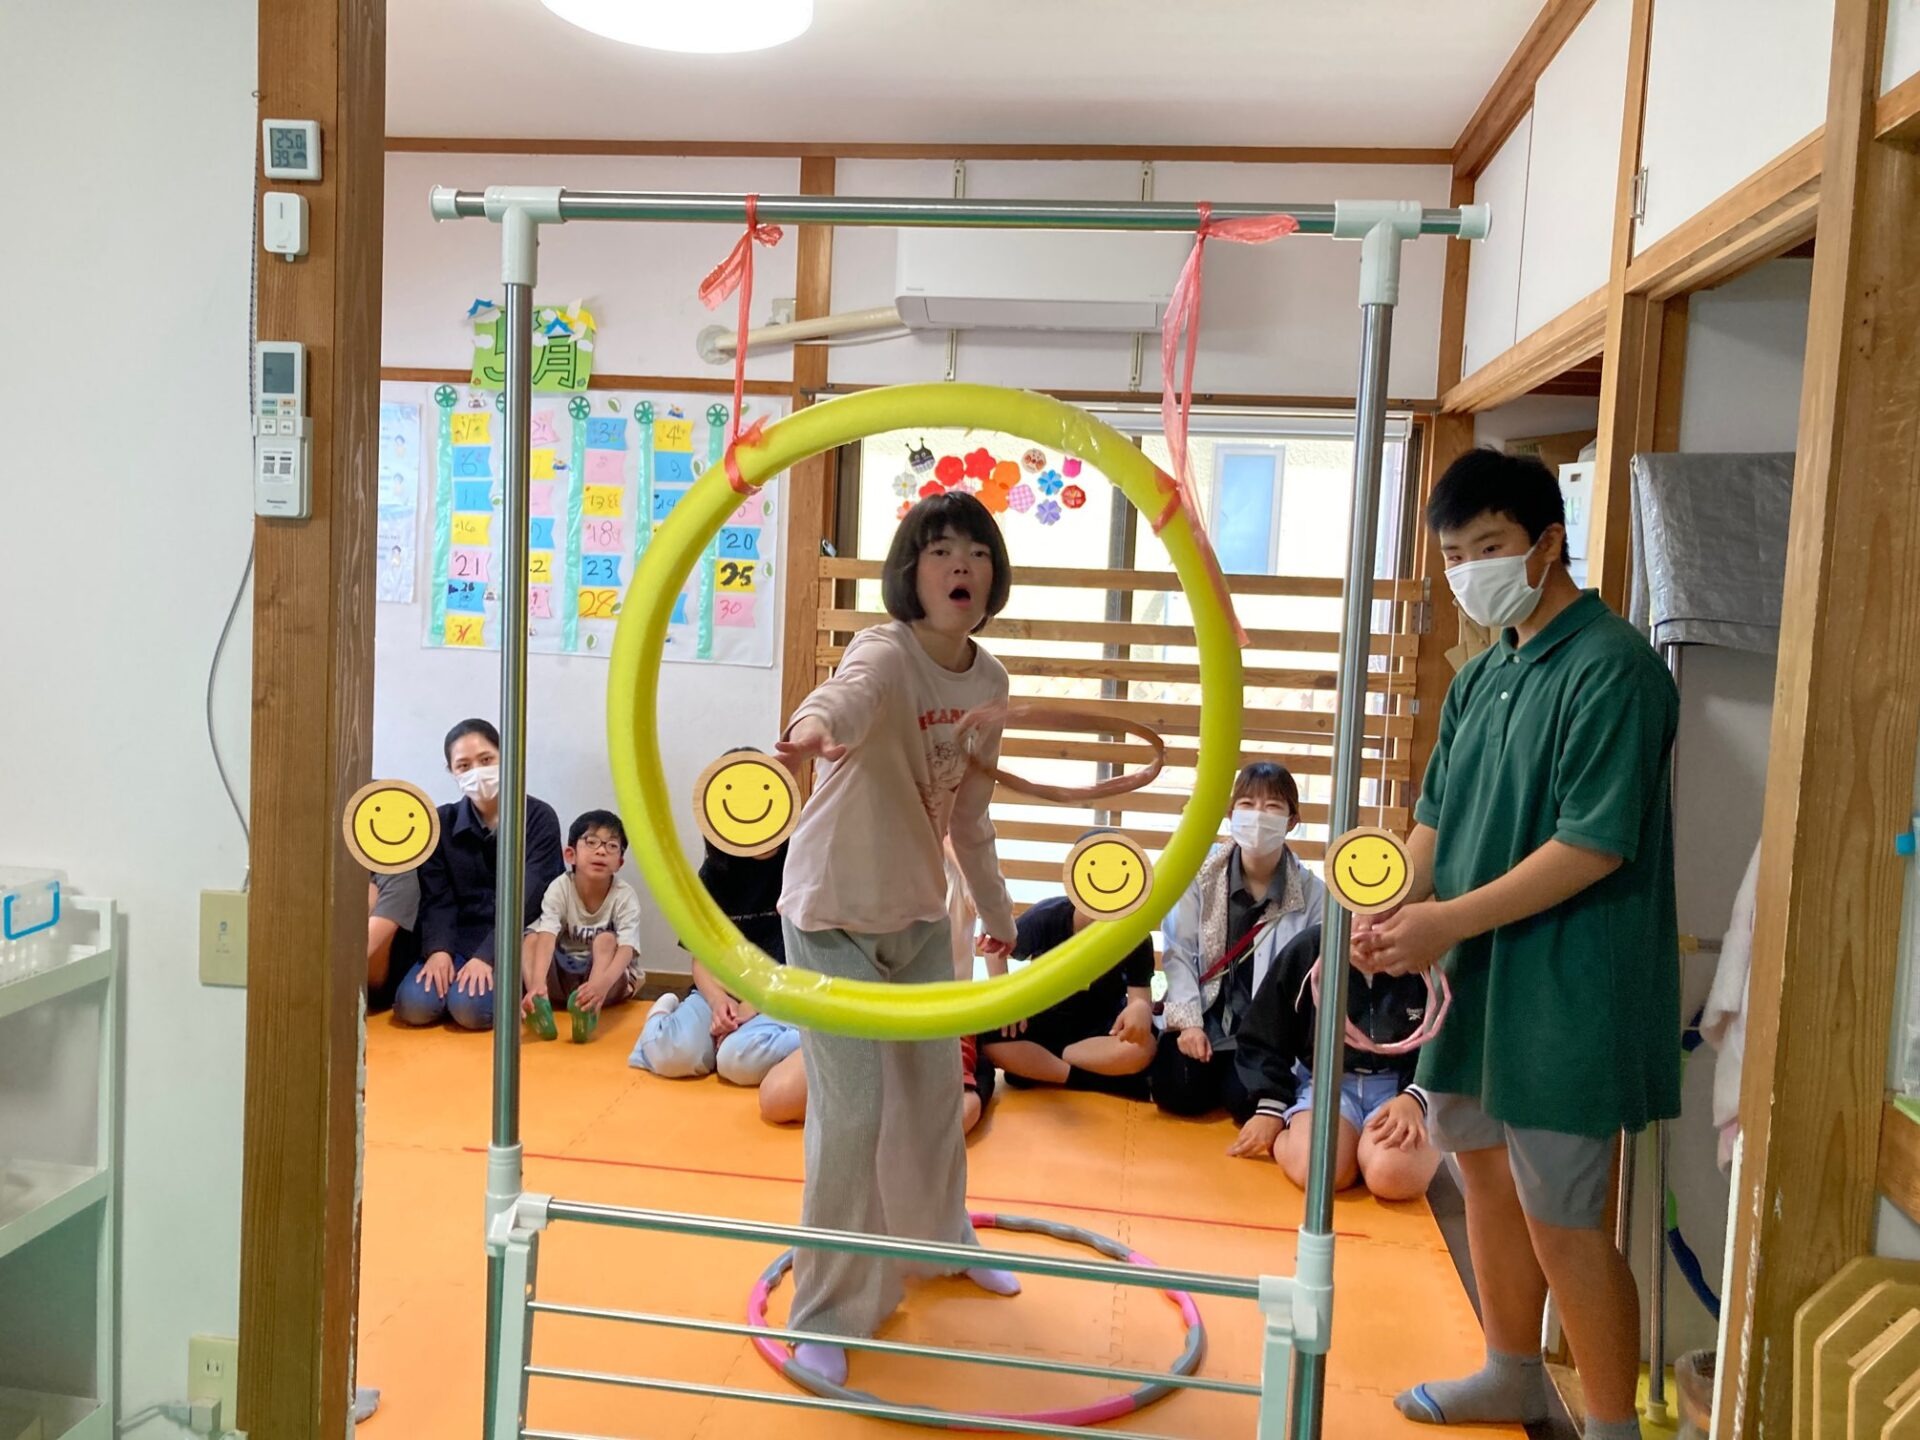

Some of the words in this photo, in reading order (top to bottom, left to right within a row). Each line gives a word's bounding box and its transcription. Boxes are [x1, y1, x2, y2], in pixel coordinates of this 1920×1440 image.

[461, 449, 478, 476] 6
[725, 532, 754, 551] 20
[455, 554, 480, 577] 21
[586, 558, 613, 580] 23
[720, 561, 755, 587] 25
[578, 589, 618, 618] 28
[719, 599, 742, 620] 30
